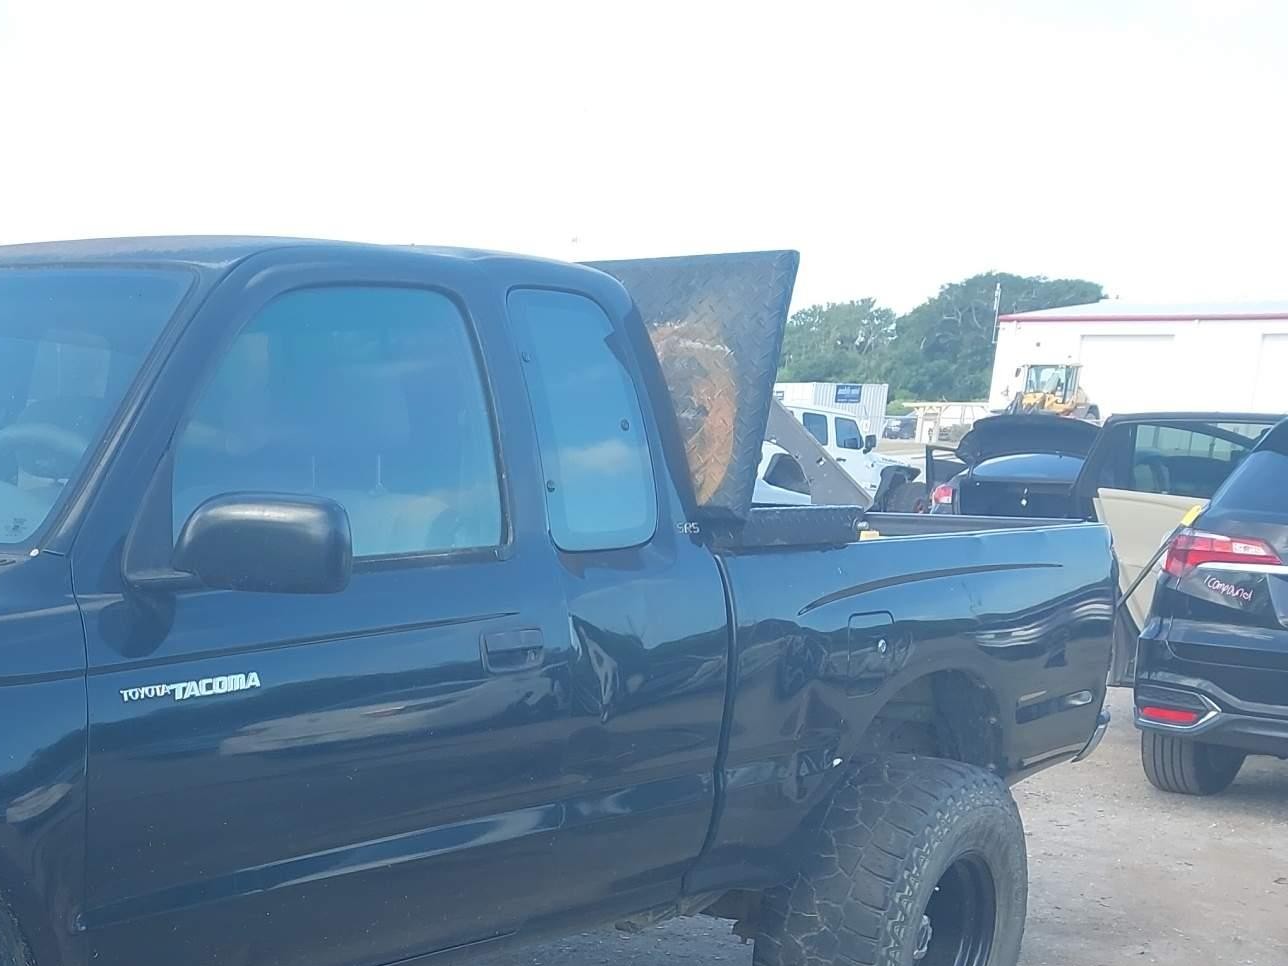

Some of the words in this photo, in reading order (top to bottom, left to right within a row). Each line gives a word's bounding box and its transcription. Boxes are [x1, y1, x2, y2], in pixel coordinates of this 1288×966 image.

[676, 521, 700, 534] SR5
[120, 684, 171, 702] TOYOTA
[169, 671, 261, 701] TACOMA
